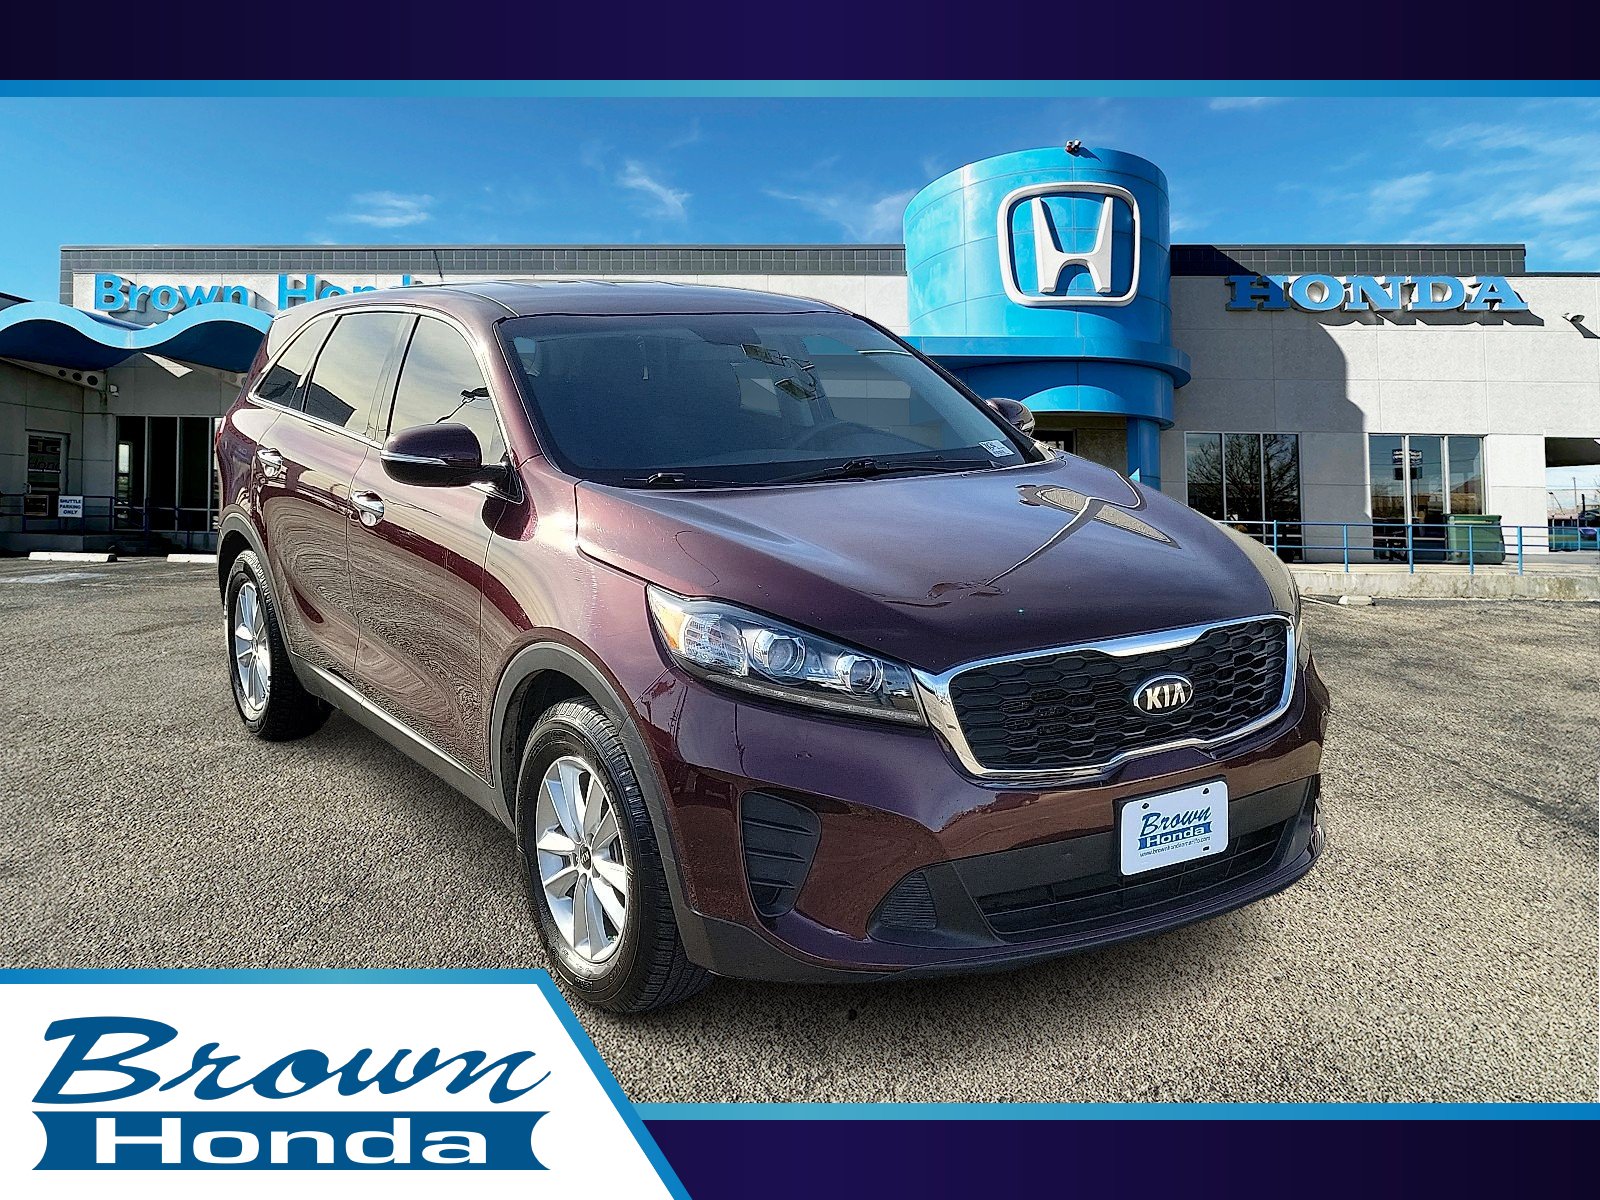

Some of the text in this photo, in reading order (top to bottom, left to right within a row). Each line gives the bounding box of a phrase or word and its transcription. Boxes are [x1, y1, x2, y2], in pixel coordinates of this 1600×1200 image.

[94, 273, 250, 312] Brown
[1226, 273, 1529, 312] HONDA
[1145, 682, 1186, 710] KIA
[1139, 806, 1212, 837] Brown
[1146, 826, 1205, 849] Honda
